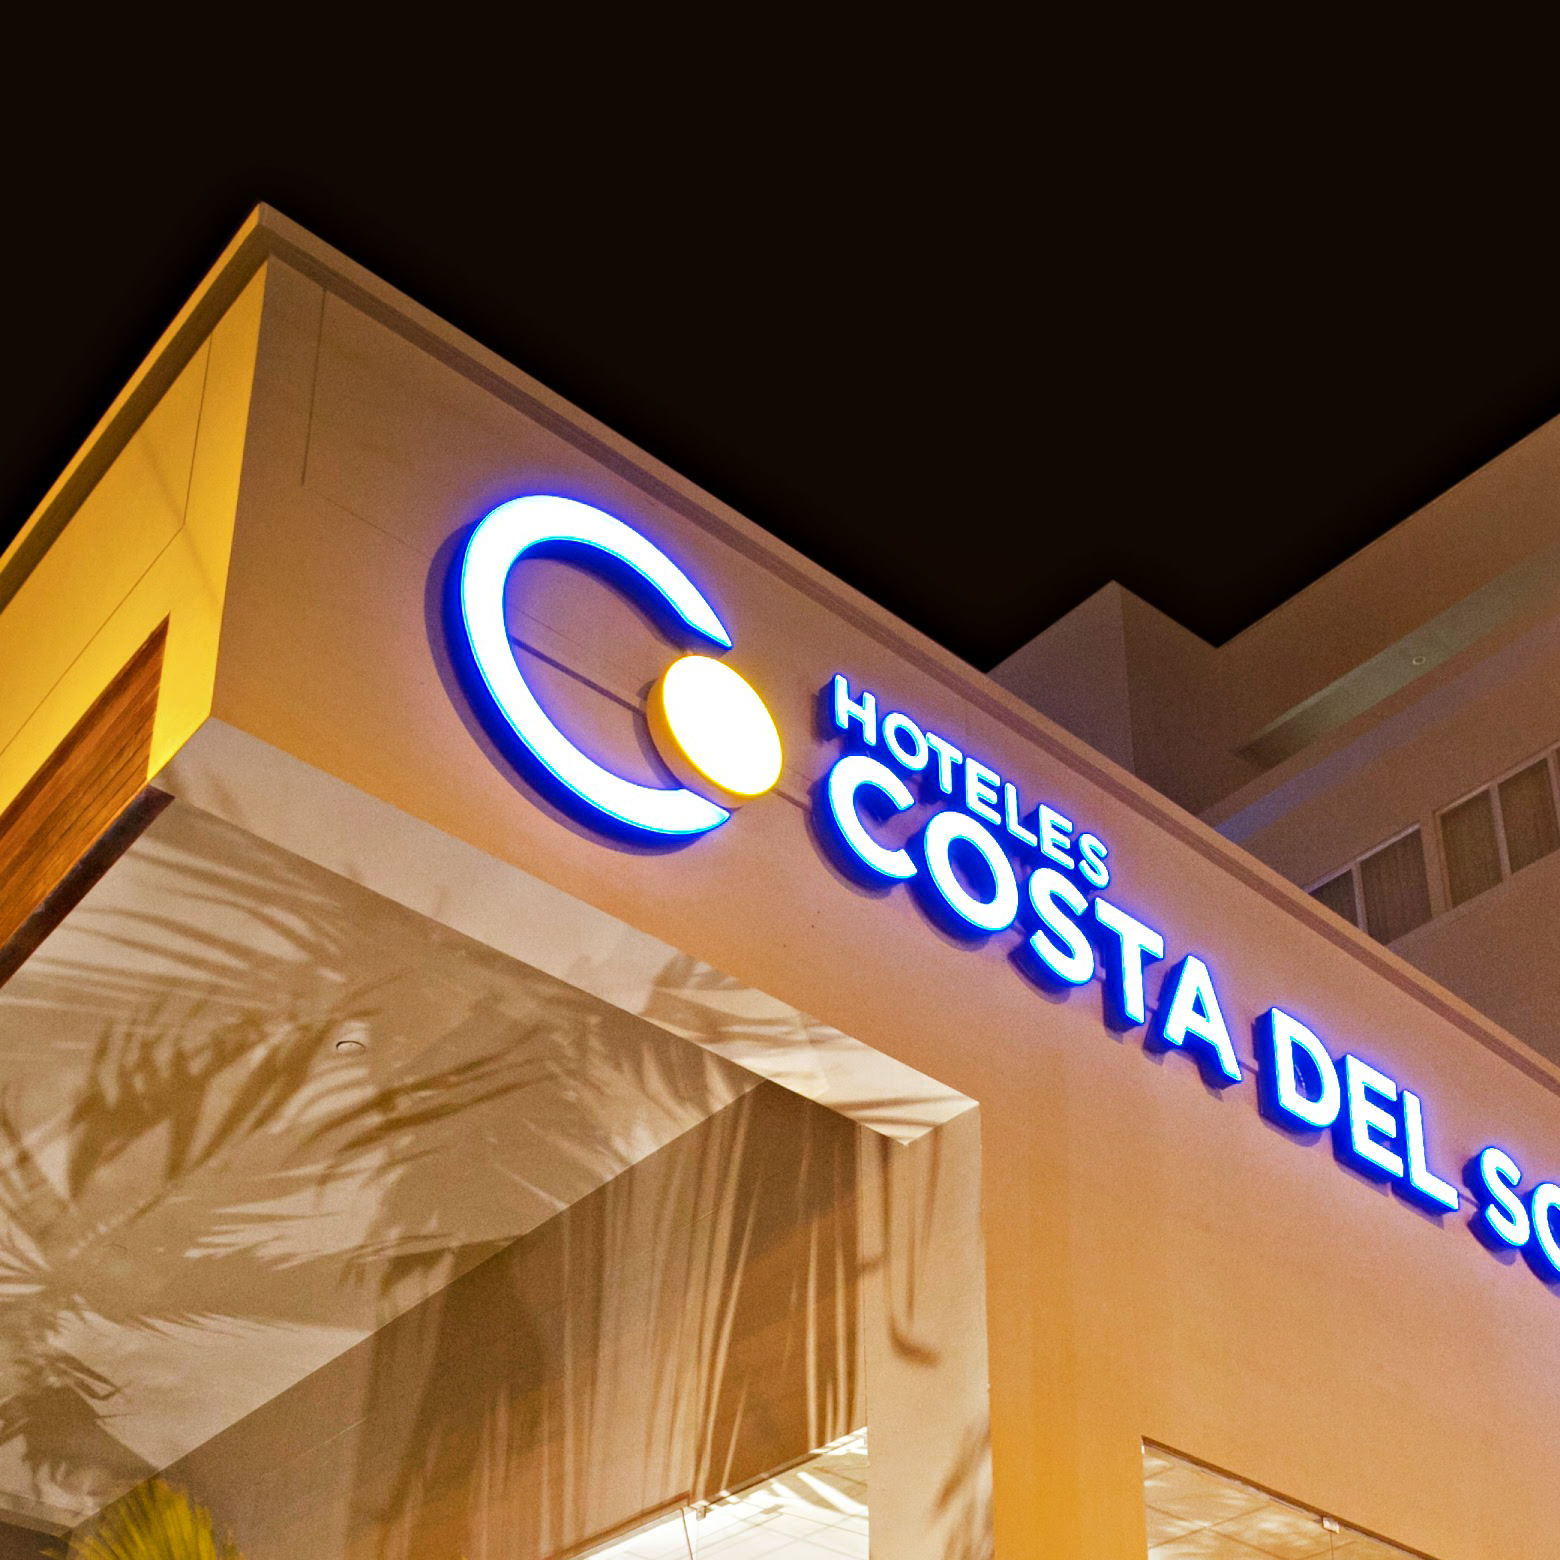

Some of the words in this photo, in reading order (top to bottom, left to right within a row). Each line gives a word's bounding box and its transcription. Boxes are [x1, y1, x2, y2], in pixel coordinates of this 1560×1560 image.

[833, 673, 1111, 890] HOTELES
[827, 754, 1243, 1083] COSTA
[1270, 1006, 1460, 1211] DEL
